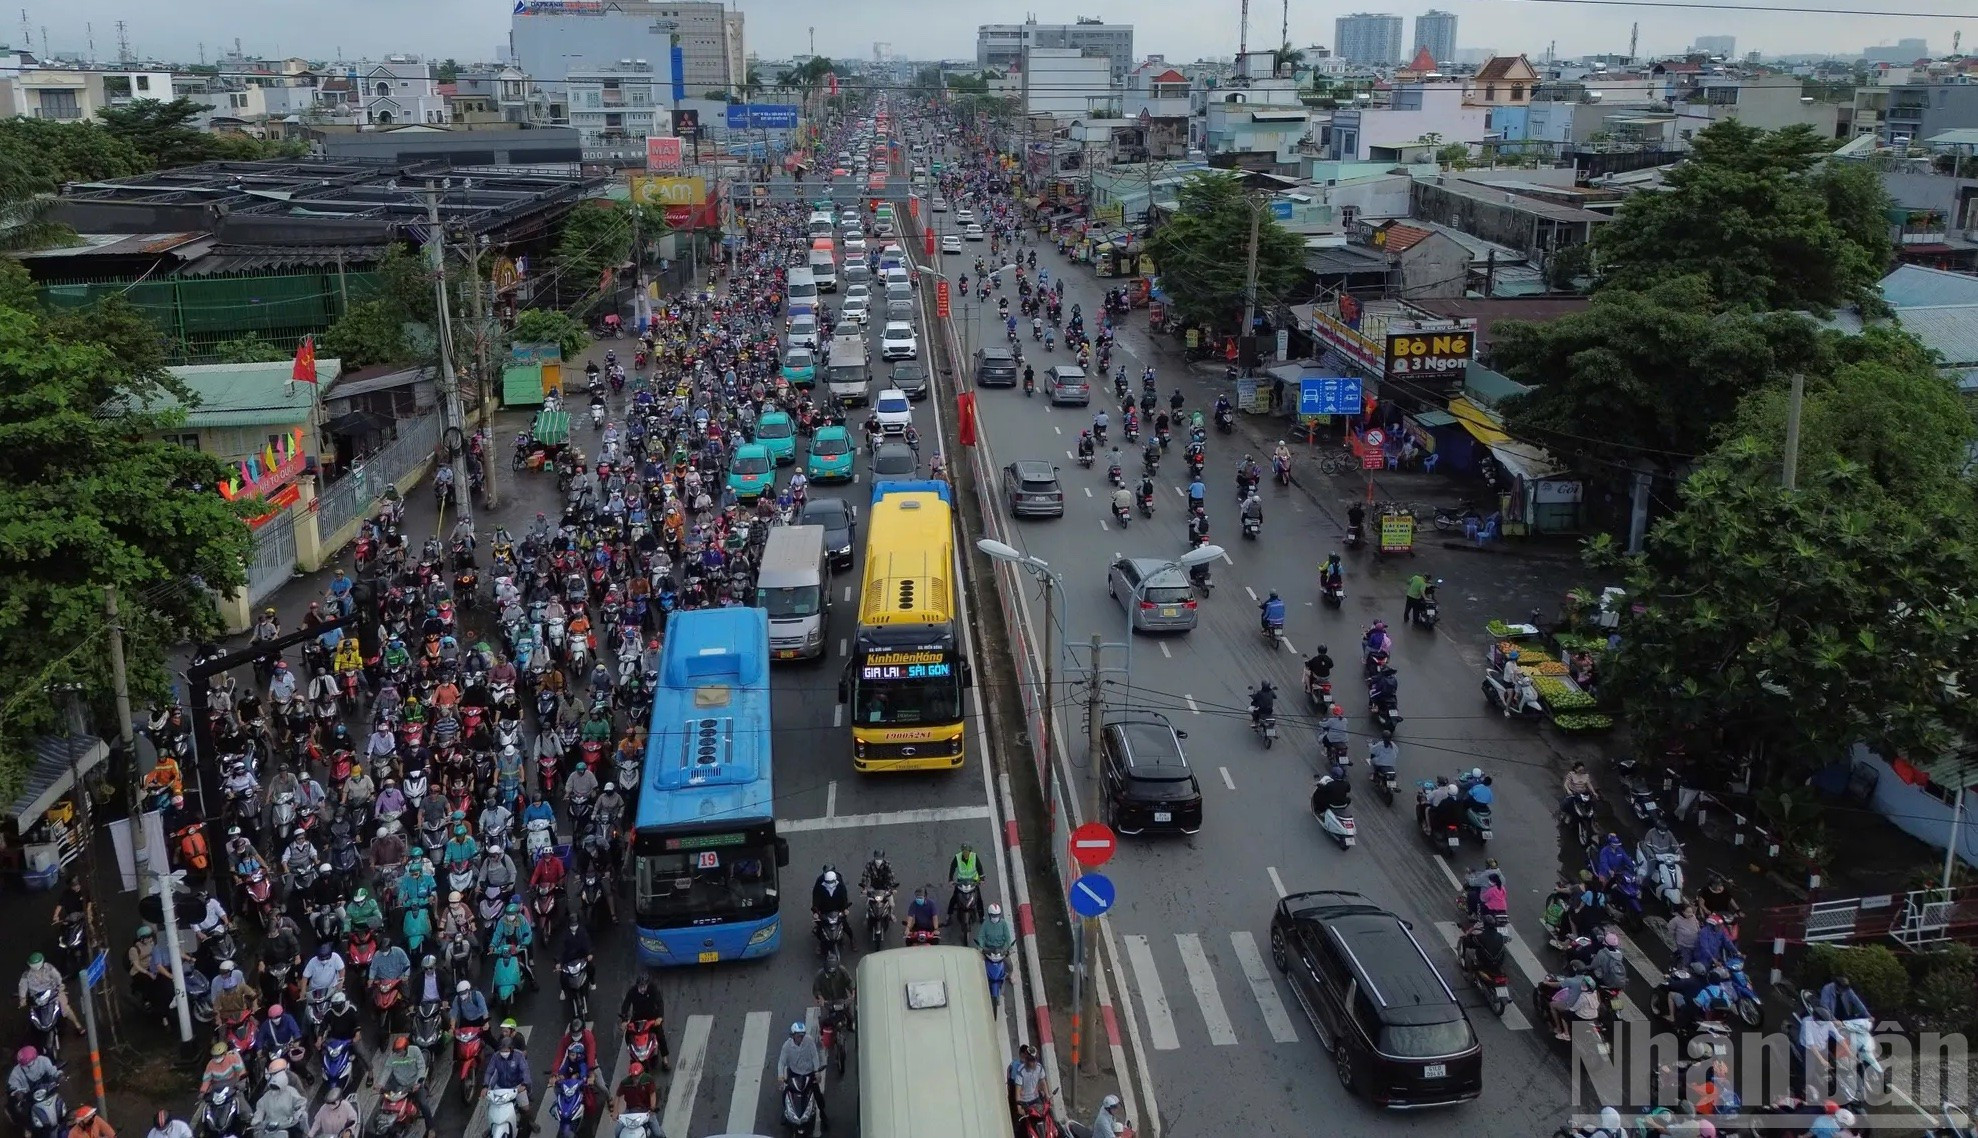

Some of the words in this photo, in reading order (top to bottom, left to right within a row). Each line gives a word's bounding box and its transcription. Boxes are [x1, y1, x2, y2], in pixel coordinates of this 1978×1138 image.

[1394, 337, 1427, 356] Bò
[1433, 335, 1467, 354] Né
[1412, 359, 1421, 370] 3
[1425, 356, 1468, 372] Ngon
[864, 667, 881, 678] GIA
[883, 667, 900, 678] LAI
[908, 663, 926, 677] SÀI
[928, 663, 949, 677] GÒN
[700, 853, 717, 867] 19
